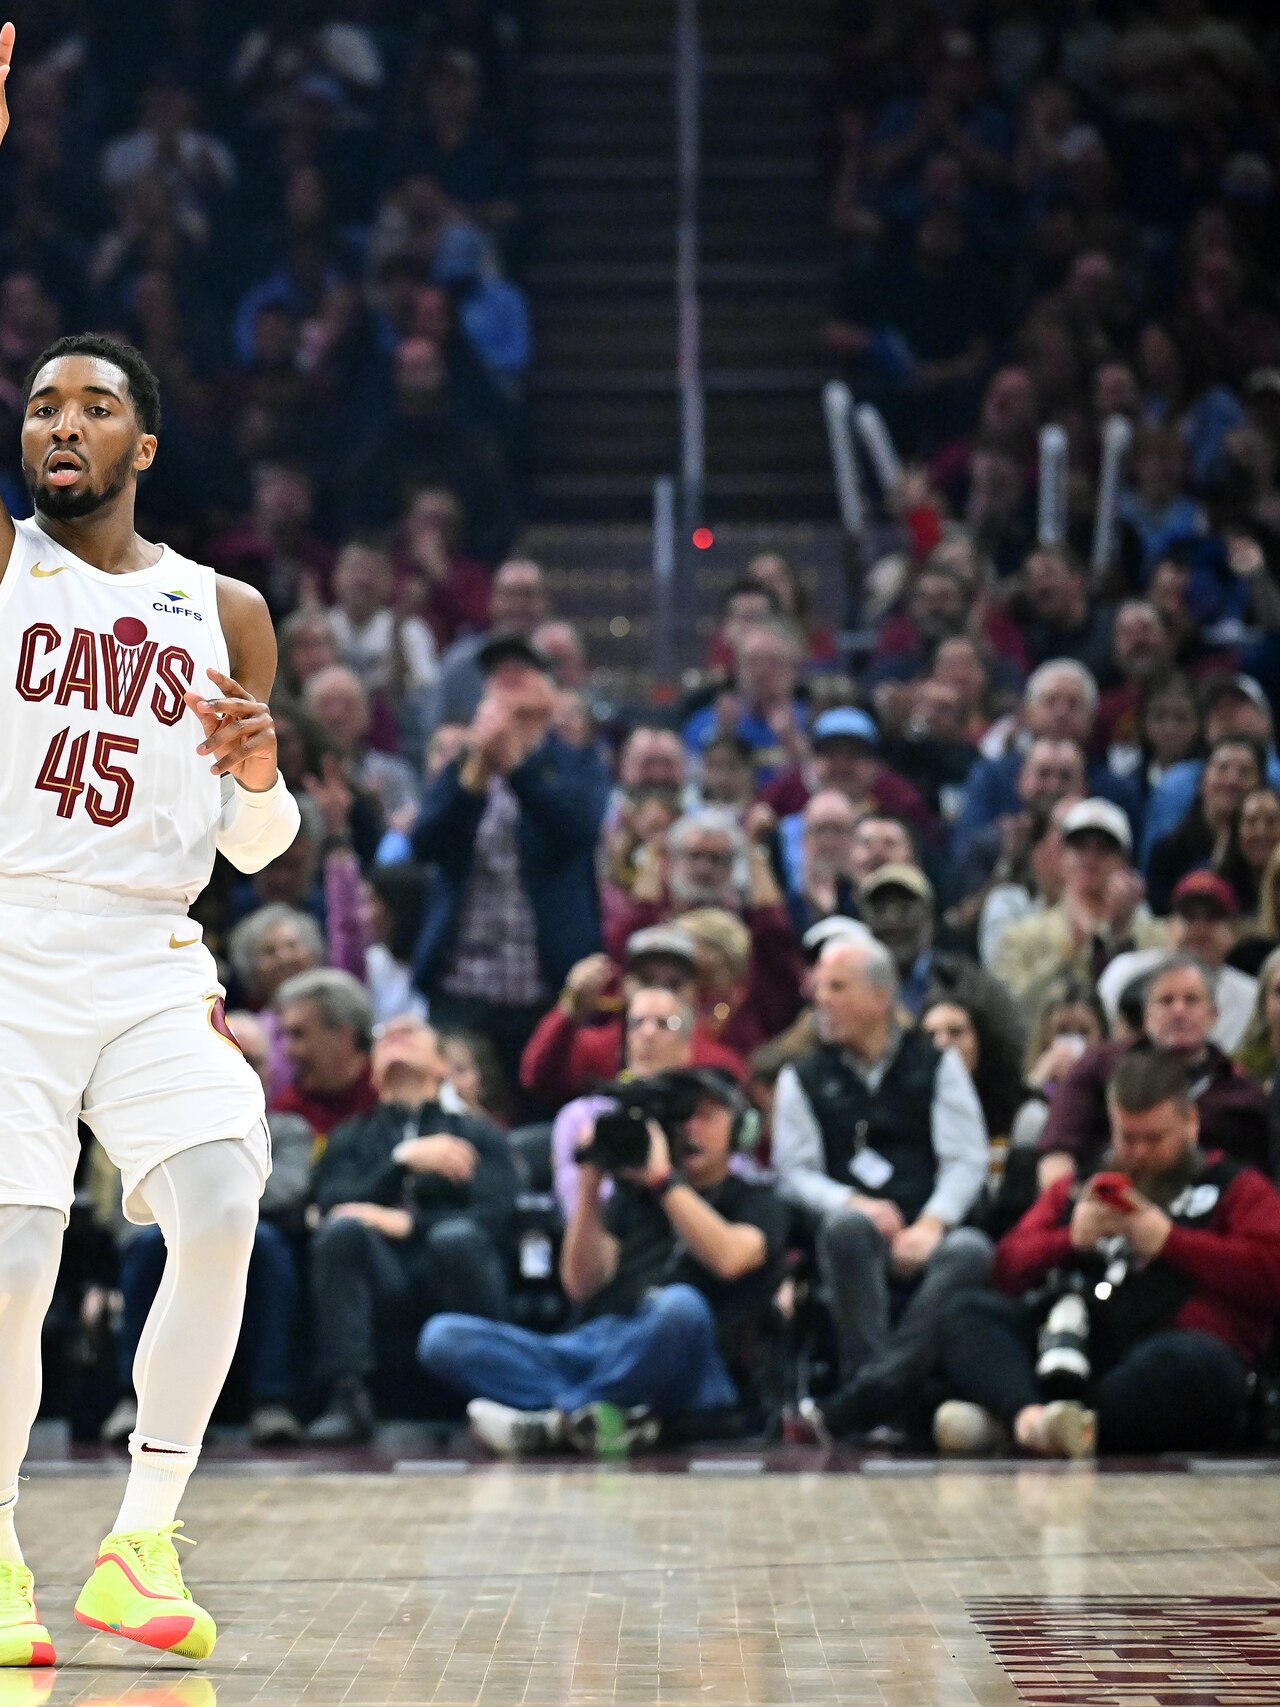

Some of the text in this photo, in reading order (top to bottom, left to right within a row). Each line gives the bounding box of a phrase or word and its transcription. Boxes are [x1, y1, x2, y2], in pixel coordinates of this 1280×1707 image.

[152, 602, 203, 621] CLIFFS
[15, 621, 195, 727] CAVS
[35, 725, 139, 828] 45
